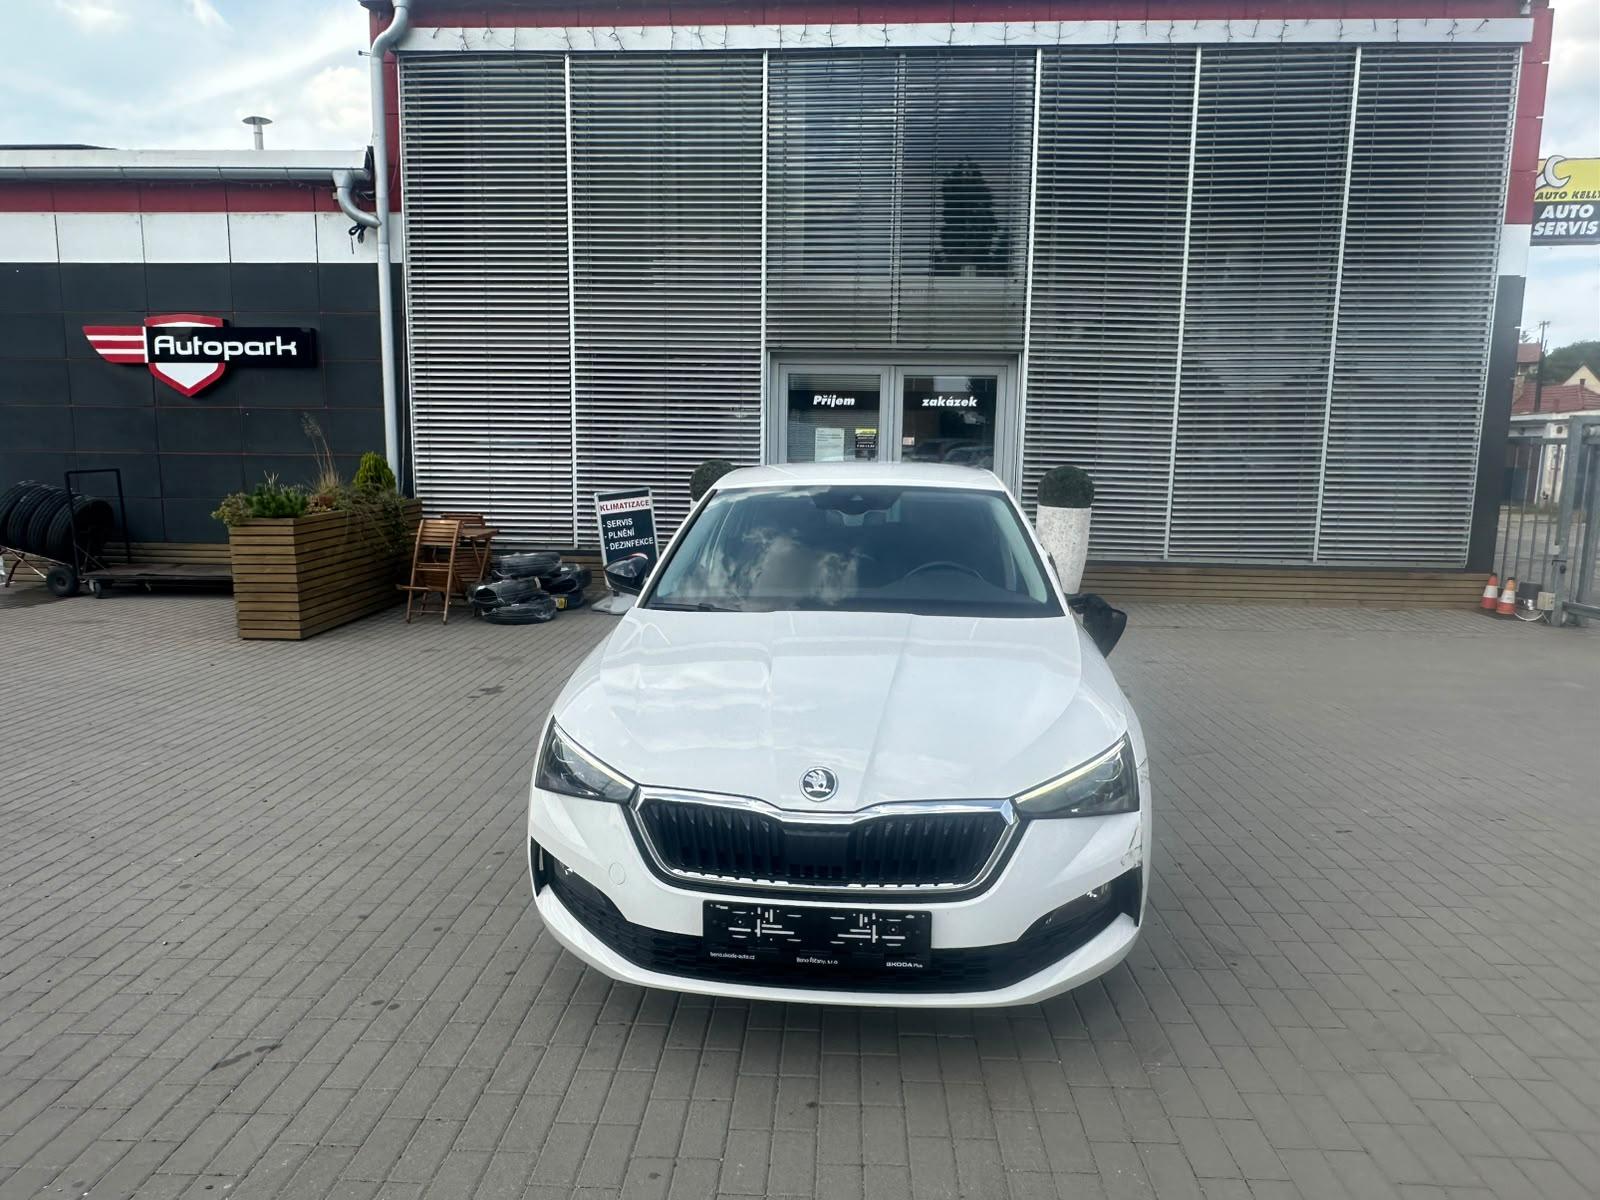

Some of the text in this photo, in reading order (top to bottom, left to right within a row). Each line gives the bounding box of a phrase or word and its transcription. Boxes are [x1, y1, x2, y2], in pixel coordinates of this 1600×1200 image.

[1536, 191, 1568, 200] AUTO
[1540, 204, 1594, 219] AUTO
[1532, 221, 1599, 236] SERVIS
[154, 335, 297, 361] Autopark
[813, 395, 977, 408] Příjem zakázek
[600, 501, 649, 511] KLIMATIZACE
[609, 536, 654, 550] DEZINFEKCE
